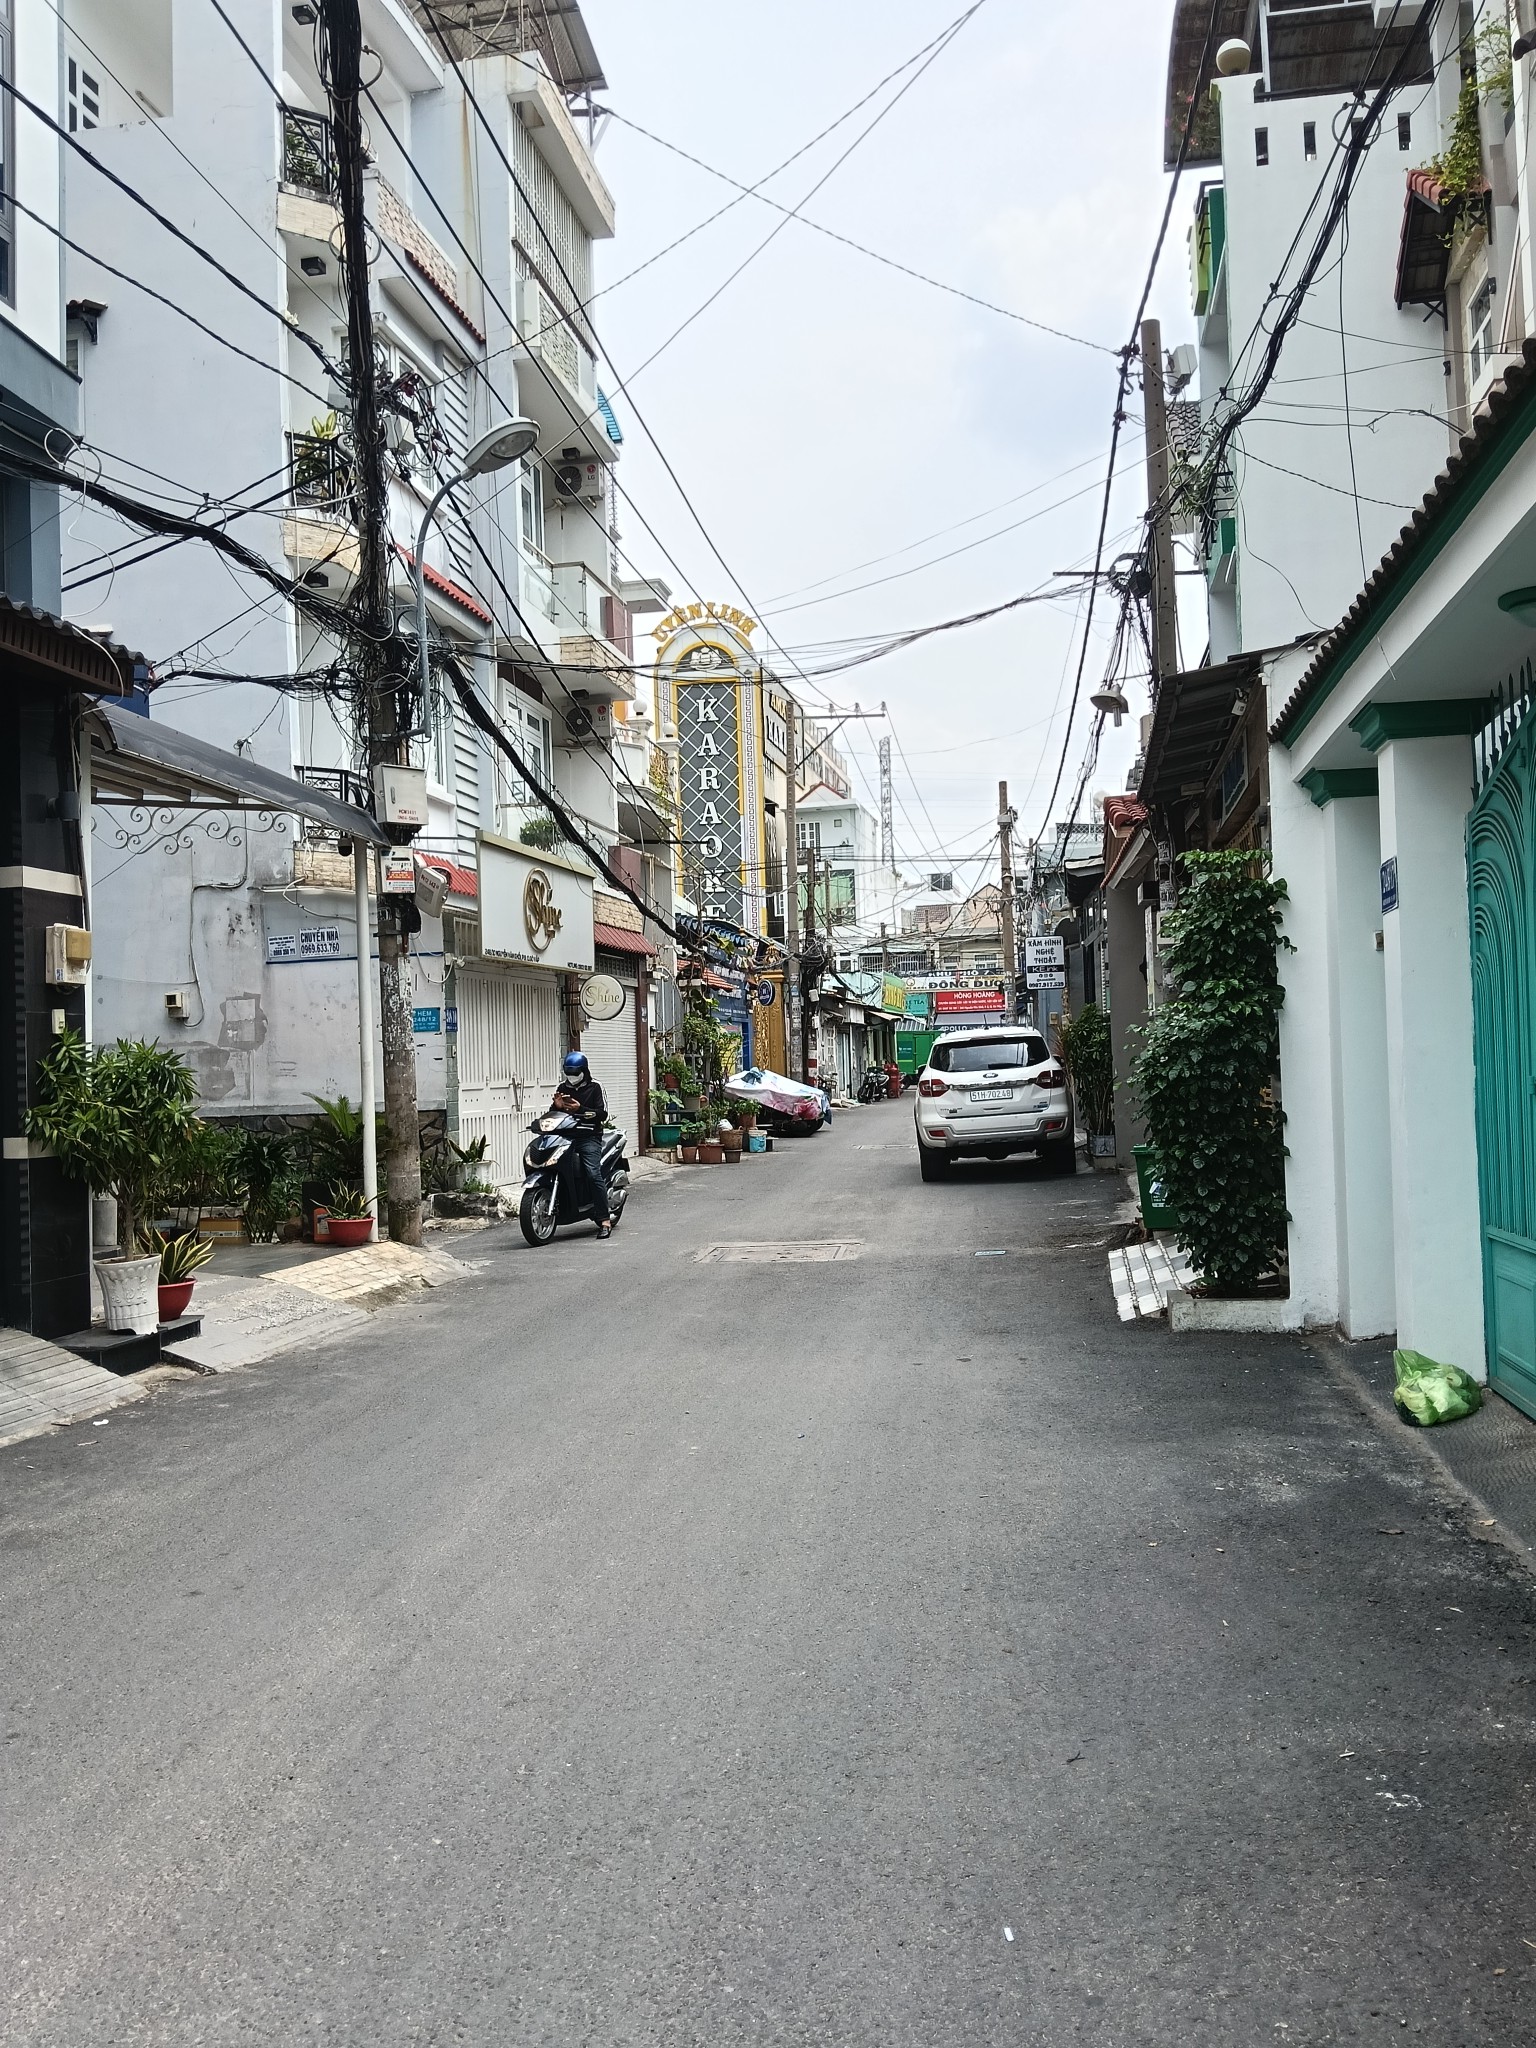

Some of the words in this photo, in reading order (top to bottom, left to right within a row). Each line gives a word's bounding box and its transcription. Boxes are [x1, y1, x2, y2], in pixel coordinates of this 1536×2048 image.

[651, 602, 701, 642] UYÊN
[706, 602, 758, 636] LINH
[300, 942, 340, 954] 0969.633.760
[928, 979, 969, 989] ĐÔNG
[585, 985, 620, 1007] Shine
